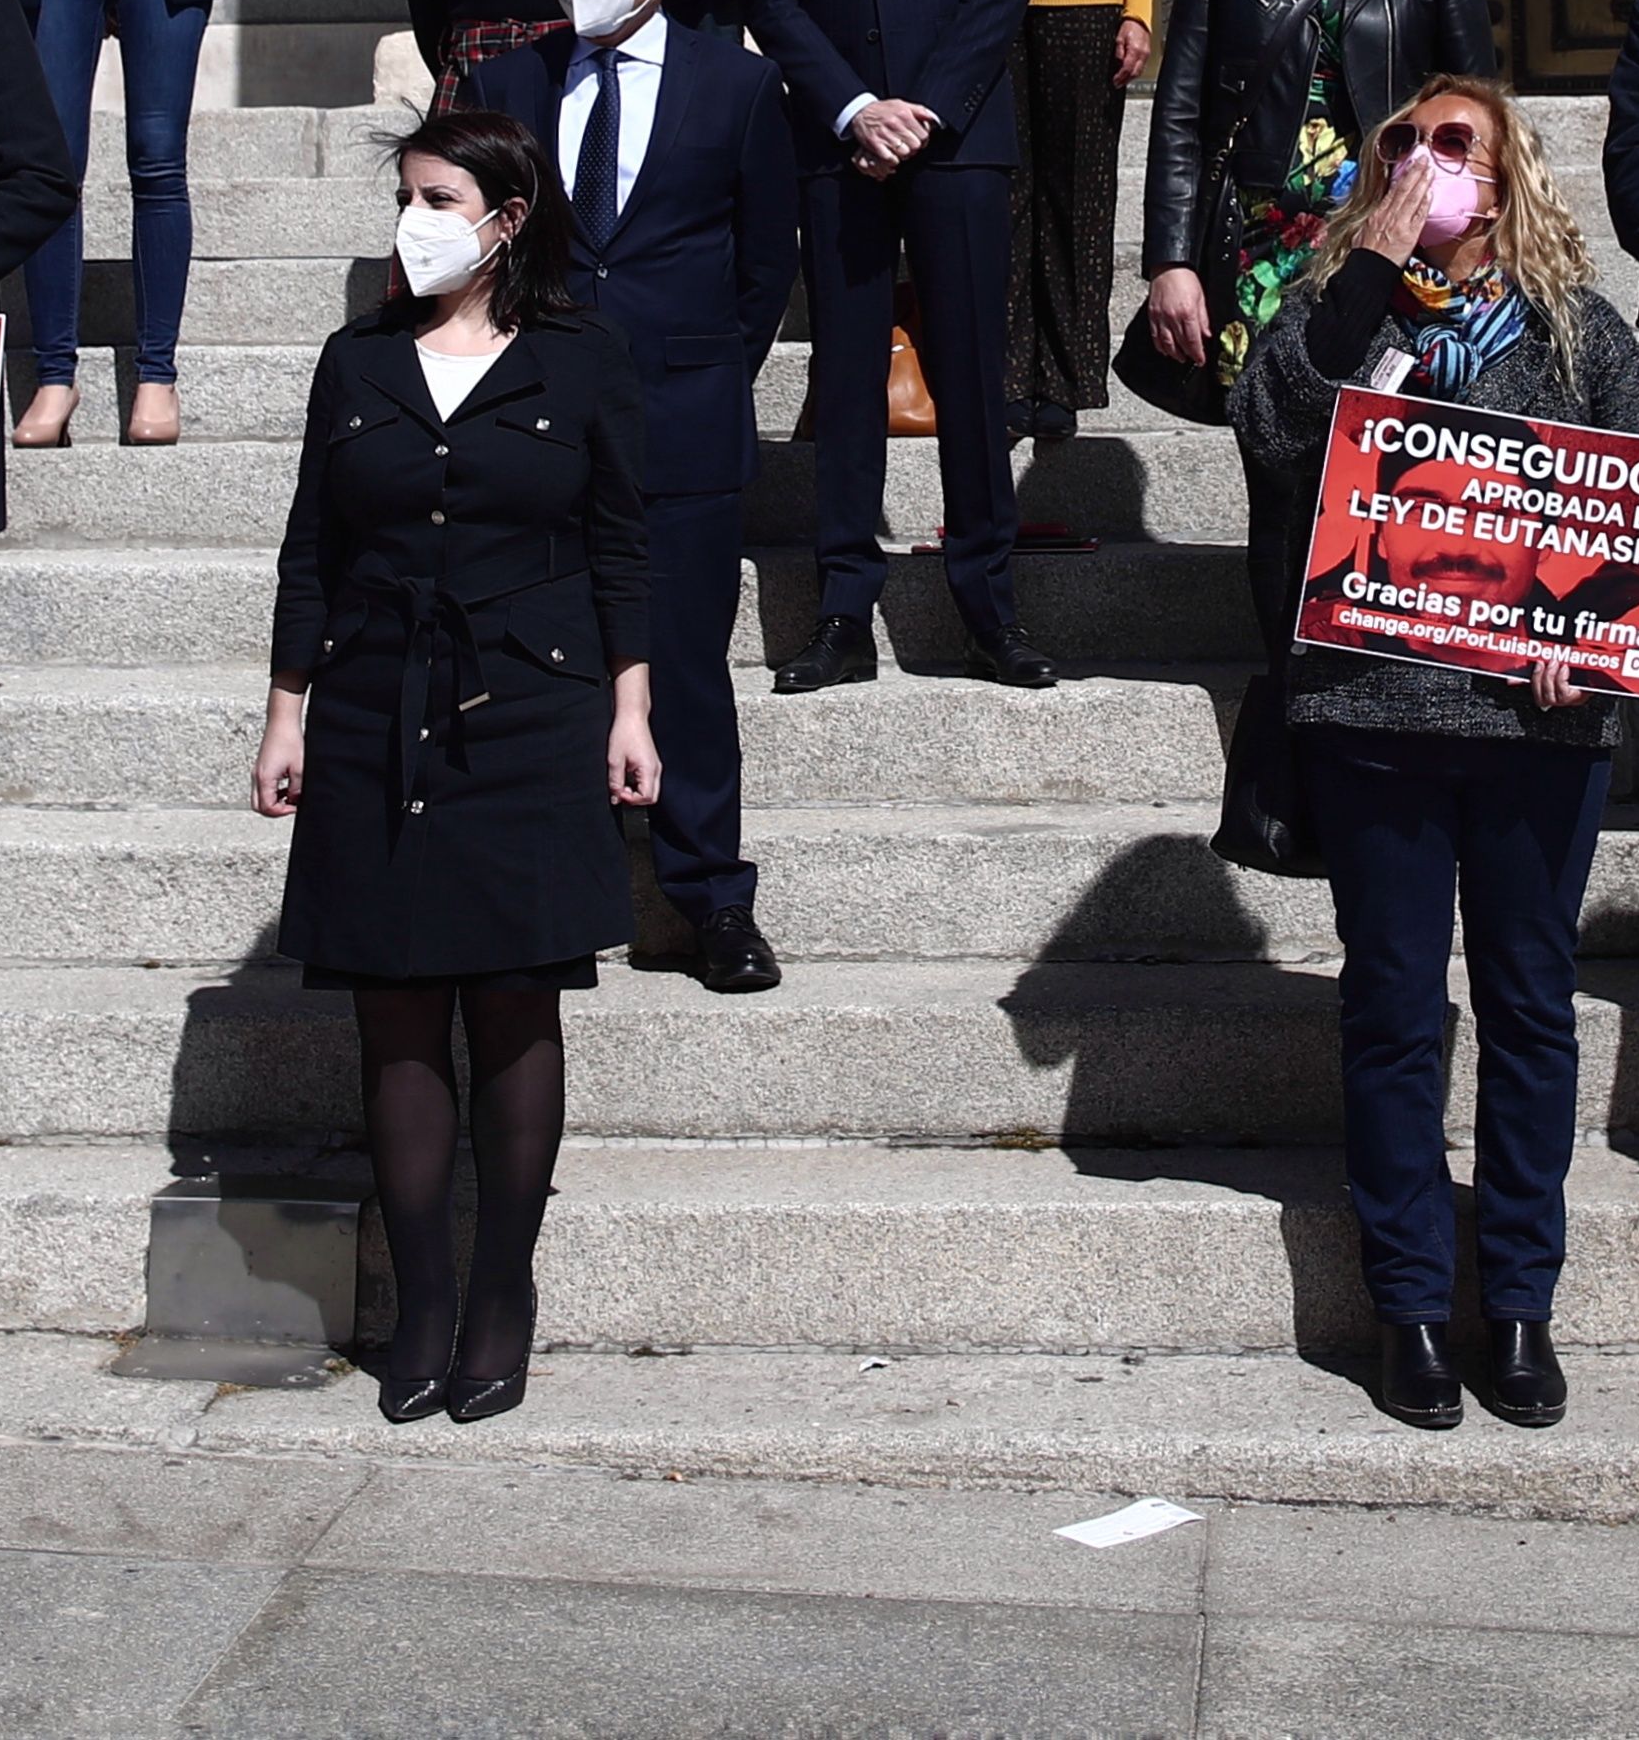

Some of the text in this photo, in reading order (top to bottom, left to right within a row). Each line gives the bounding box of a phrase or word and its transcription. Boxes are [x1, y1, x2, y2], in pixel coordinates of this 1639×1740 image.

[1349, 490, 1413, 524] LEY
[1421, 504, 1466, 535] DE
[1461, 478, 1625, 526] APROBADA
[1342, 572, 1461, 618] Gracias
[1469, 596, 1524, 629] por
[1533, 609, 1565, 636] tu
[1339, 609, 1619, 669] change.org/PorLuisDeMarcos
